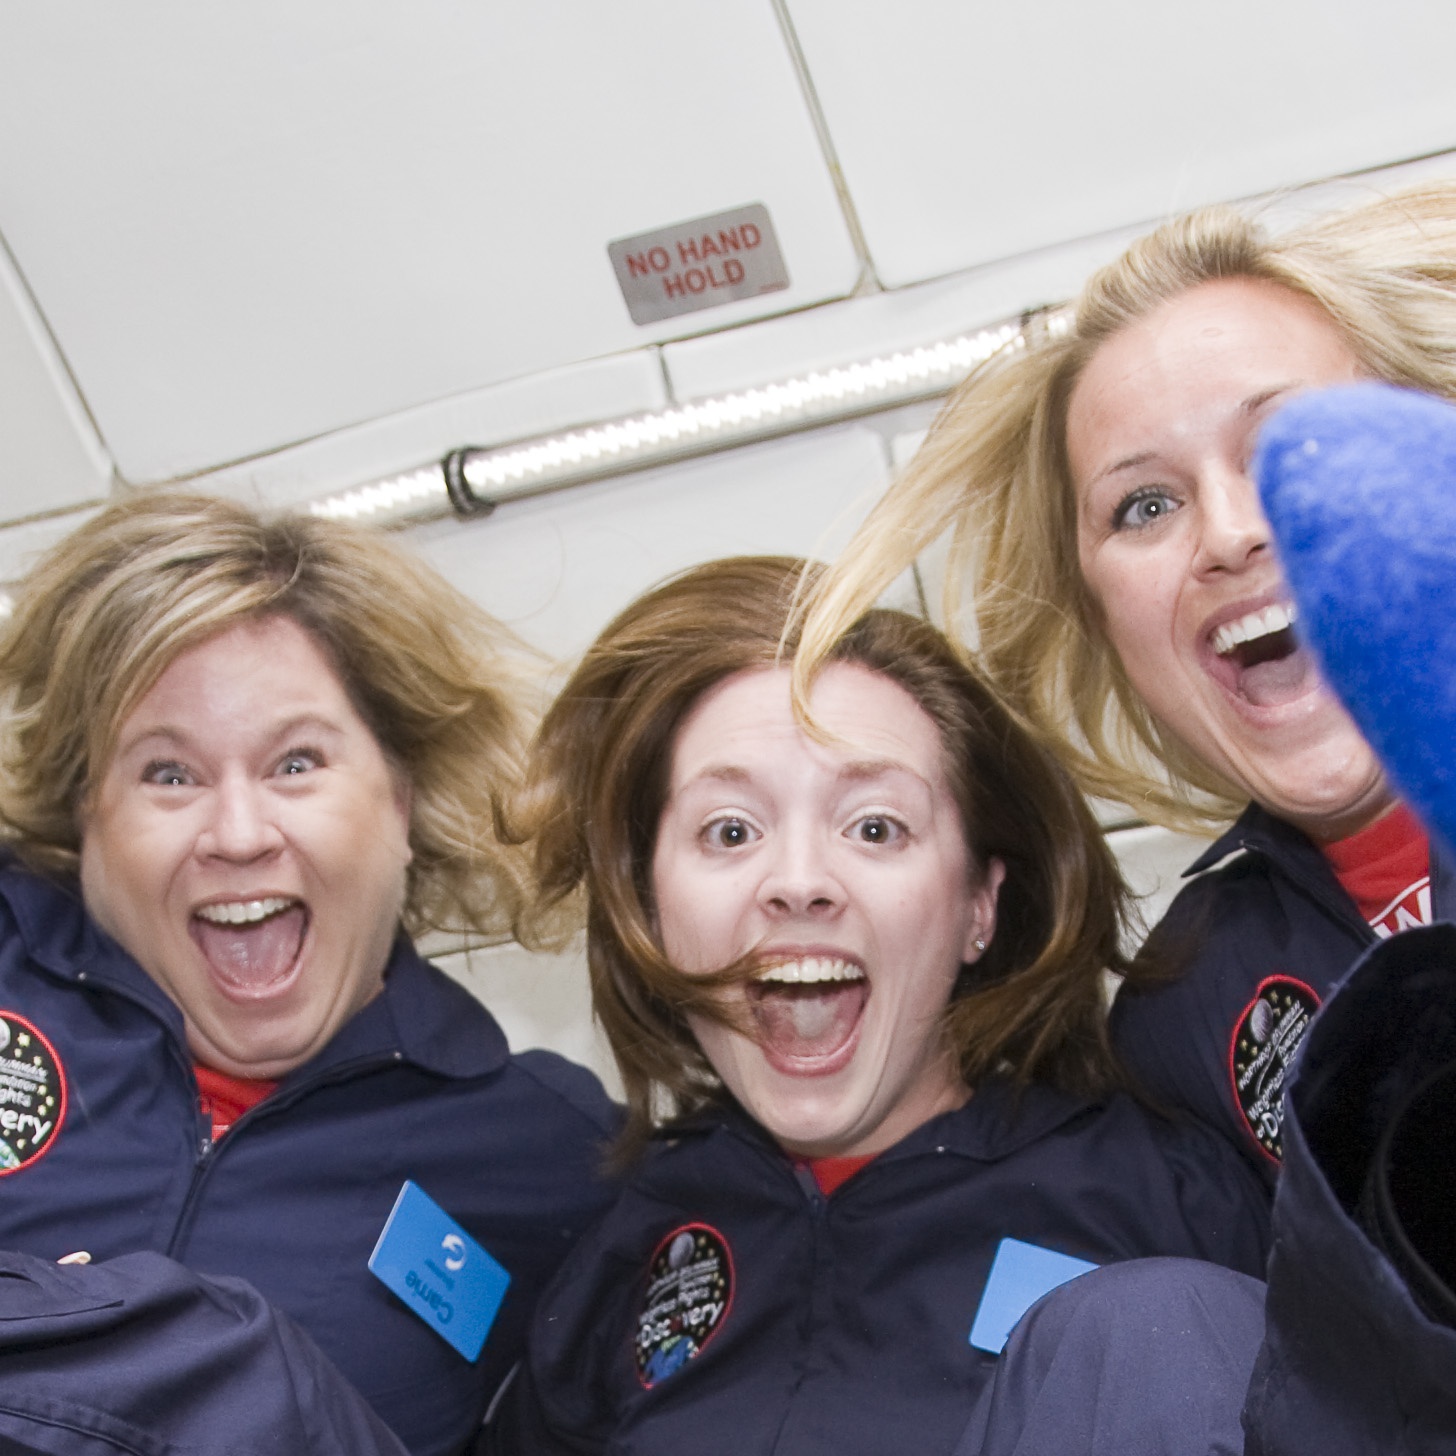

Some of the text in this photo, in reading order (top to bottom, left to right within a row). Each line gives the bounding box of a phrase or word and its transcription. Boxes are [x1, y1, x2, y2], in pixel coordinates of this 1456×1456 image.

[626, 223, 761, 278] NO HAND
[662, 258, 745, 299] HOLD
